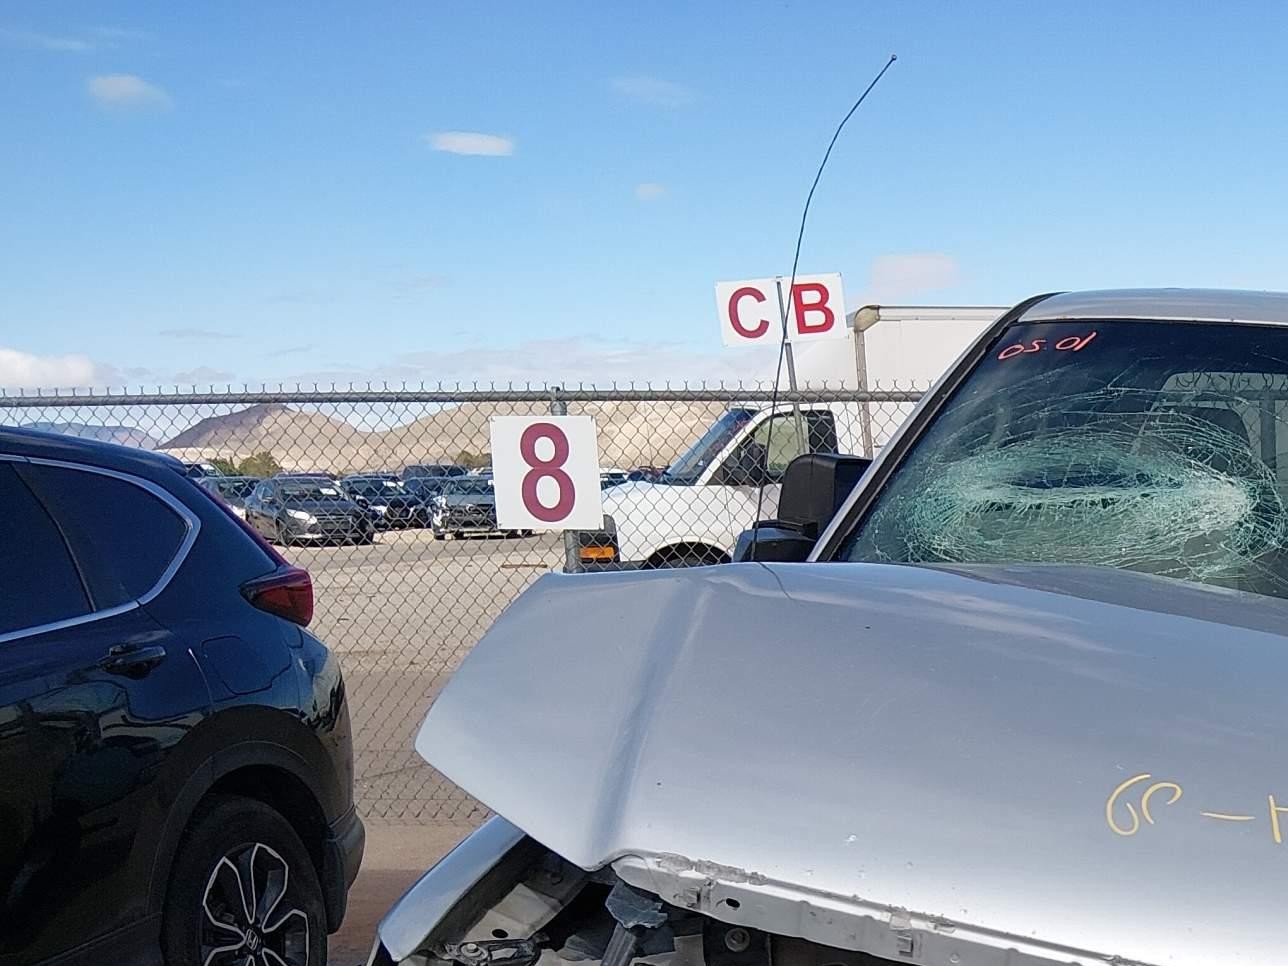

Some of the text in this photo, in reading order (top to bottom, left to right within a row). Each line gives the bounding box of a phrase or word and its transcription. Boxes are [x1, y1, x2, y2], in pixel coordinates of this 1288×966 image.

[729, 287, 769, 338] C
[793, 283, 835, 334] B
[520, 422, 575, 522] 8
